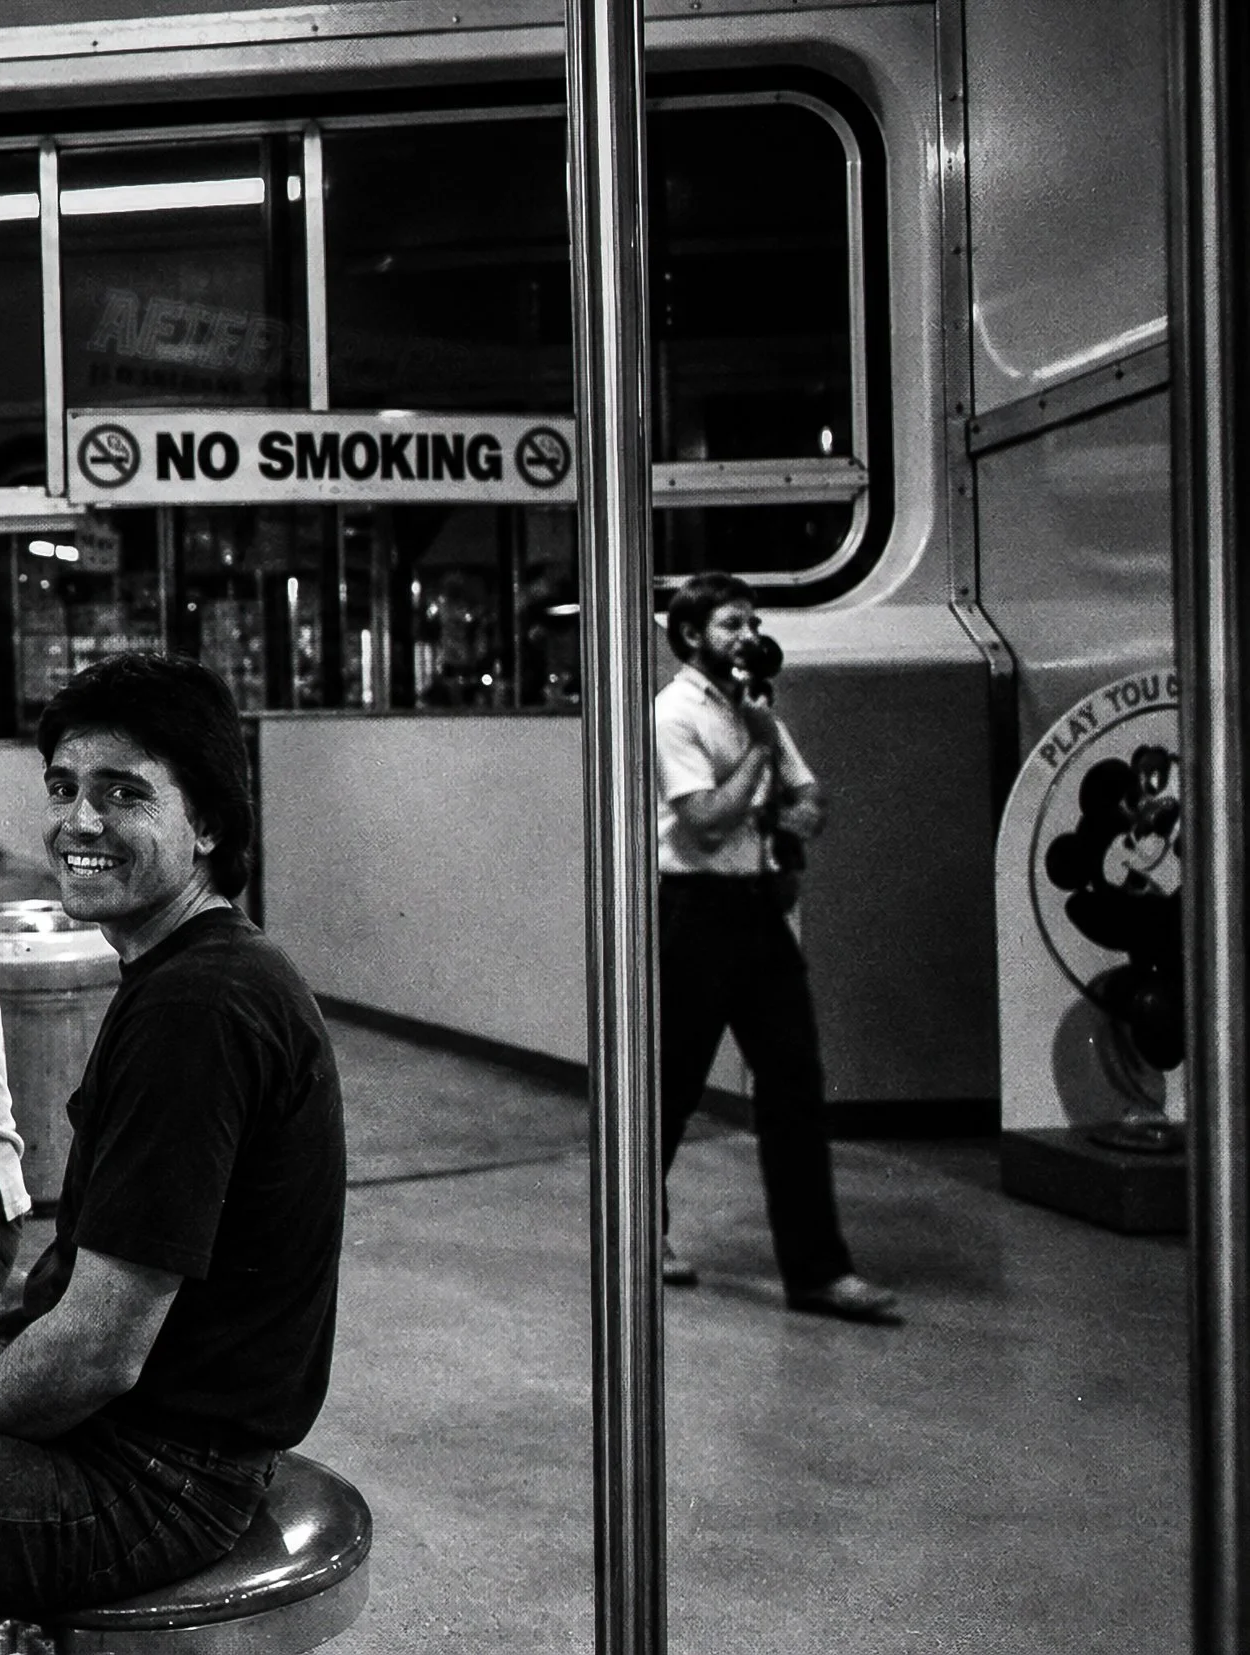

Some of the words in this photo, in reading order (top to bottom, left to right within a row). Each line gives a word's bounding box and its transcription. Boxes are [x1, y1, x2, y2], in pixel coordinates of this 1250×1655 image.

[155, 430, 240, 481] NO
[258, 430, 503, 481] SMOKING
[1039, 701, 1098, 768] PLAY
[1105, 675, 1159, 712] YOU
